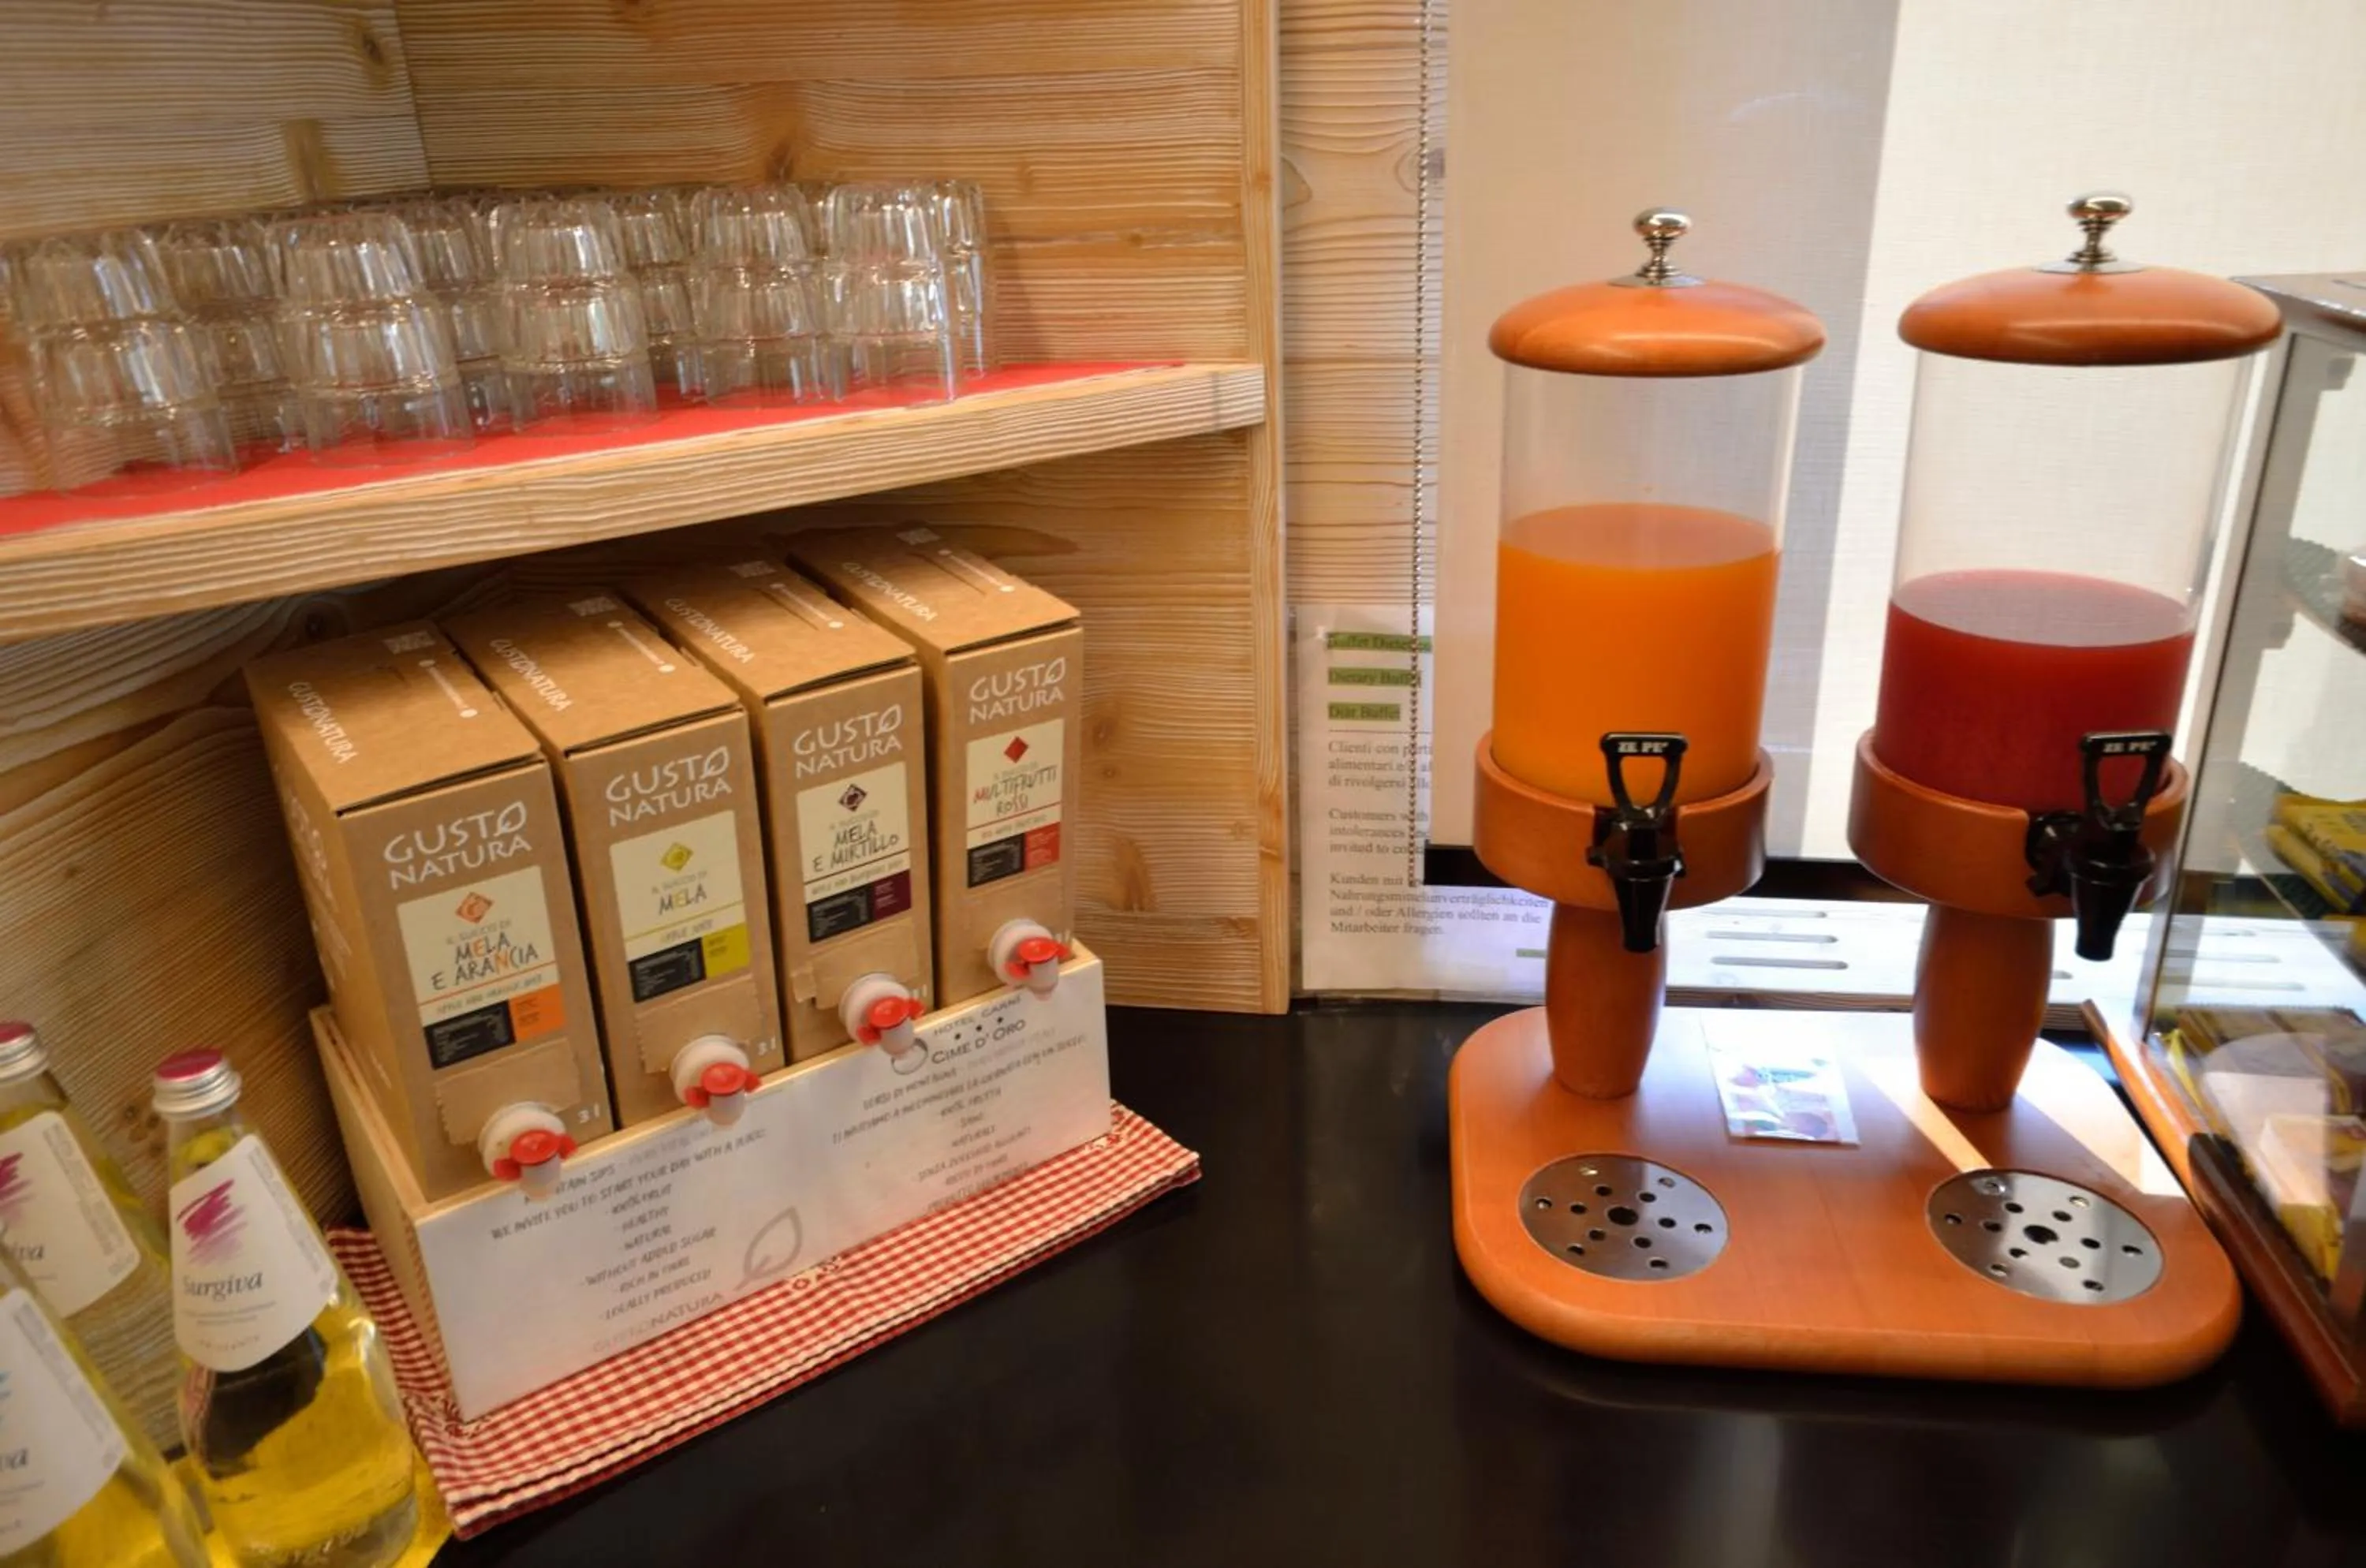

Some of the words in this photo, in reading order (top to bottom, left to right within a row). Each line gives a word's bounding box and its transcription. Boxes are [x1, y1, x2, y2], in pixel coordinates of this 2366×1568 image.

[968, 656, 1066, 703] GUSTO
[968, 685, 1064, 725] NATURA
[793, 704, 901, 756] GUSTO
[604, 744, 730, 805] GUSTO
[795, 734, 903, 779] NATURA
[607, 776, 733, 827] NATURA
[383, 800, 528, 864] GUSTO
[834, 819, 879, 849] MELA
[388, 833, 533, 890] NATURA
[812, 854, 824, 873] E
[659, 883, 707, 917] MELA
[431, 971, 447, 991] E
[453, 943, 539, 987] ARANCIA
[454, 931, 511, 965] MELA
[933, 1014, 976, 1036] HOTEL
[992, 1019, 1026, 1043] ORO
[183, 1271, 263, 1303] Surgiva
